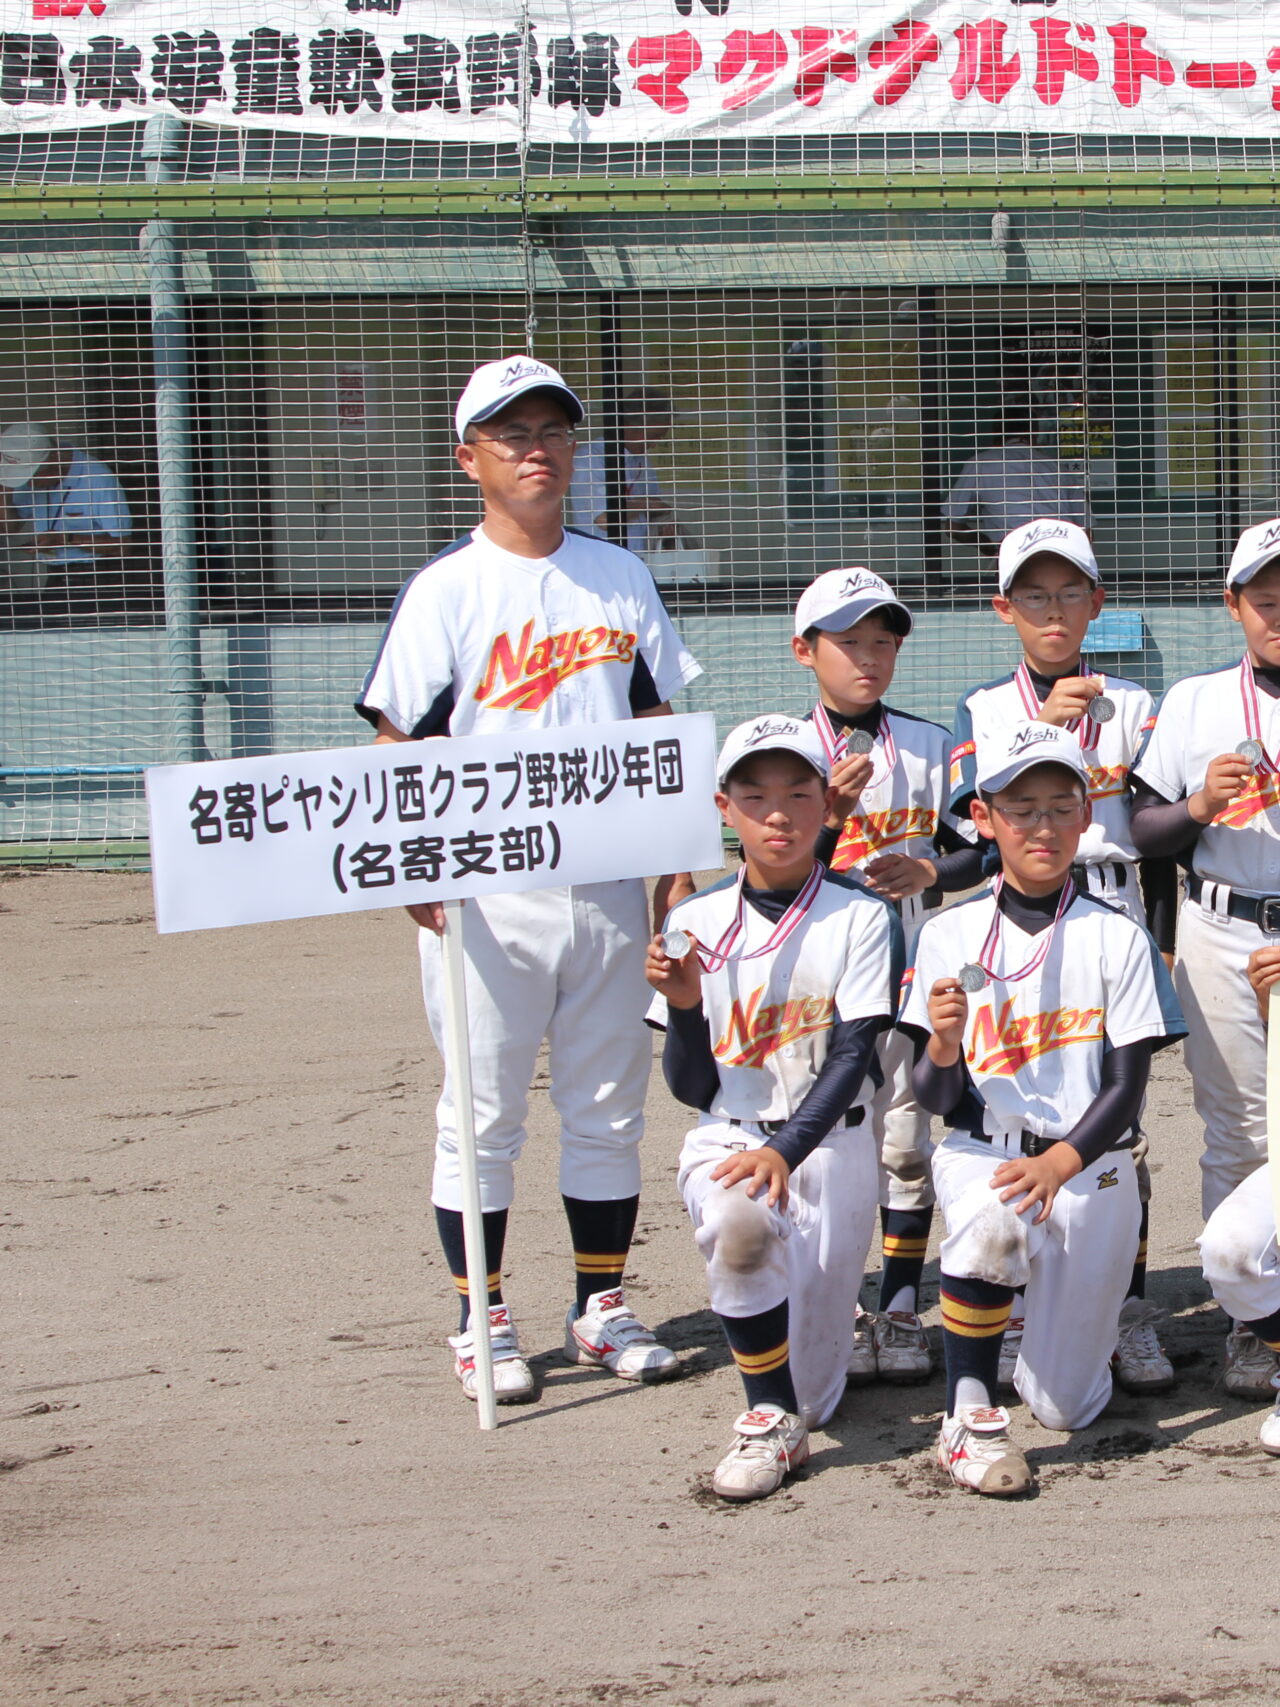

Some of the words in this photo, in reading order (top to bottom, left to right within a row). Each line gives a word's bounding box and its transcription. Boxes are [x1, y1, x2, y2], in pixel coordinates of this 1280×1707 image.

[500, 361, 549, 387] Nishi
[1017, 525, 1070, 554] Nishi
[839, 573, 884, 598] Nishi
[474, 617, 638, 712] Nayoro
[744, 719, 799, 746] Nishi
[1007, 726, 1059, 756] Nishi
[188, 738, 685, 845] 名寄ピヤシリ西クラブ野球少年団
[332, 820, 562, 894] (名寄支部)
[966, 995, 1103, 1076] Nayor
